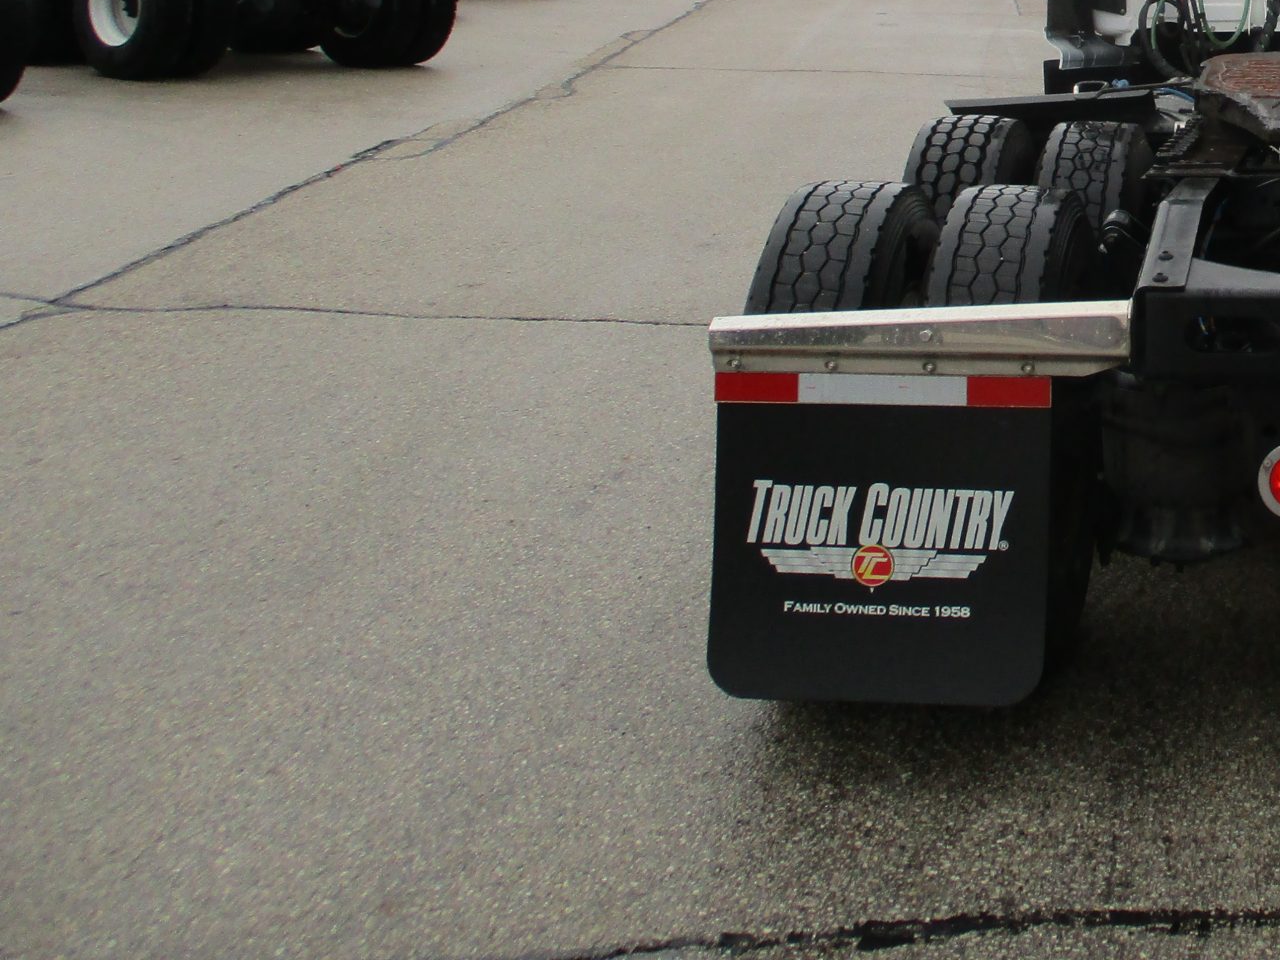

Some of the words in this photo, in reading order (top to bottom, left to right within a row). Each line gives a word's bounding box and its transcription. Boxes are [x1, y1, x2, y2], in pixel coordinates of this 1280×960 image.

[746, 479, 857, 546] TRUCK
[858, 483, 1014, 551] COUNTRY
[783, 600, 831, 615] FAMILY
[834, 602, 886, 617] OWNED
[888, 603, 930, 618] SINCE
[934, 605, 971, 618] 1958
